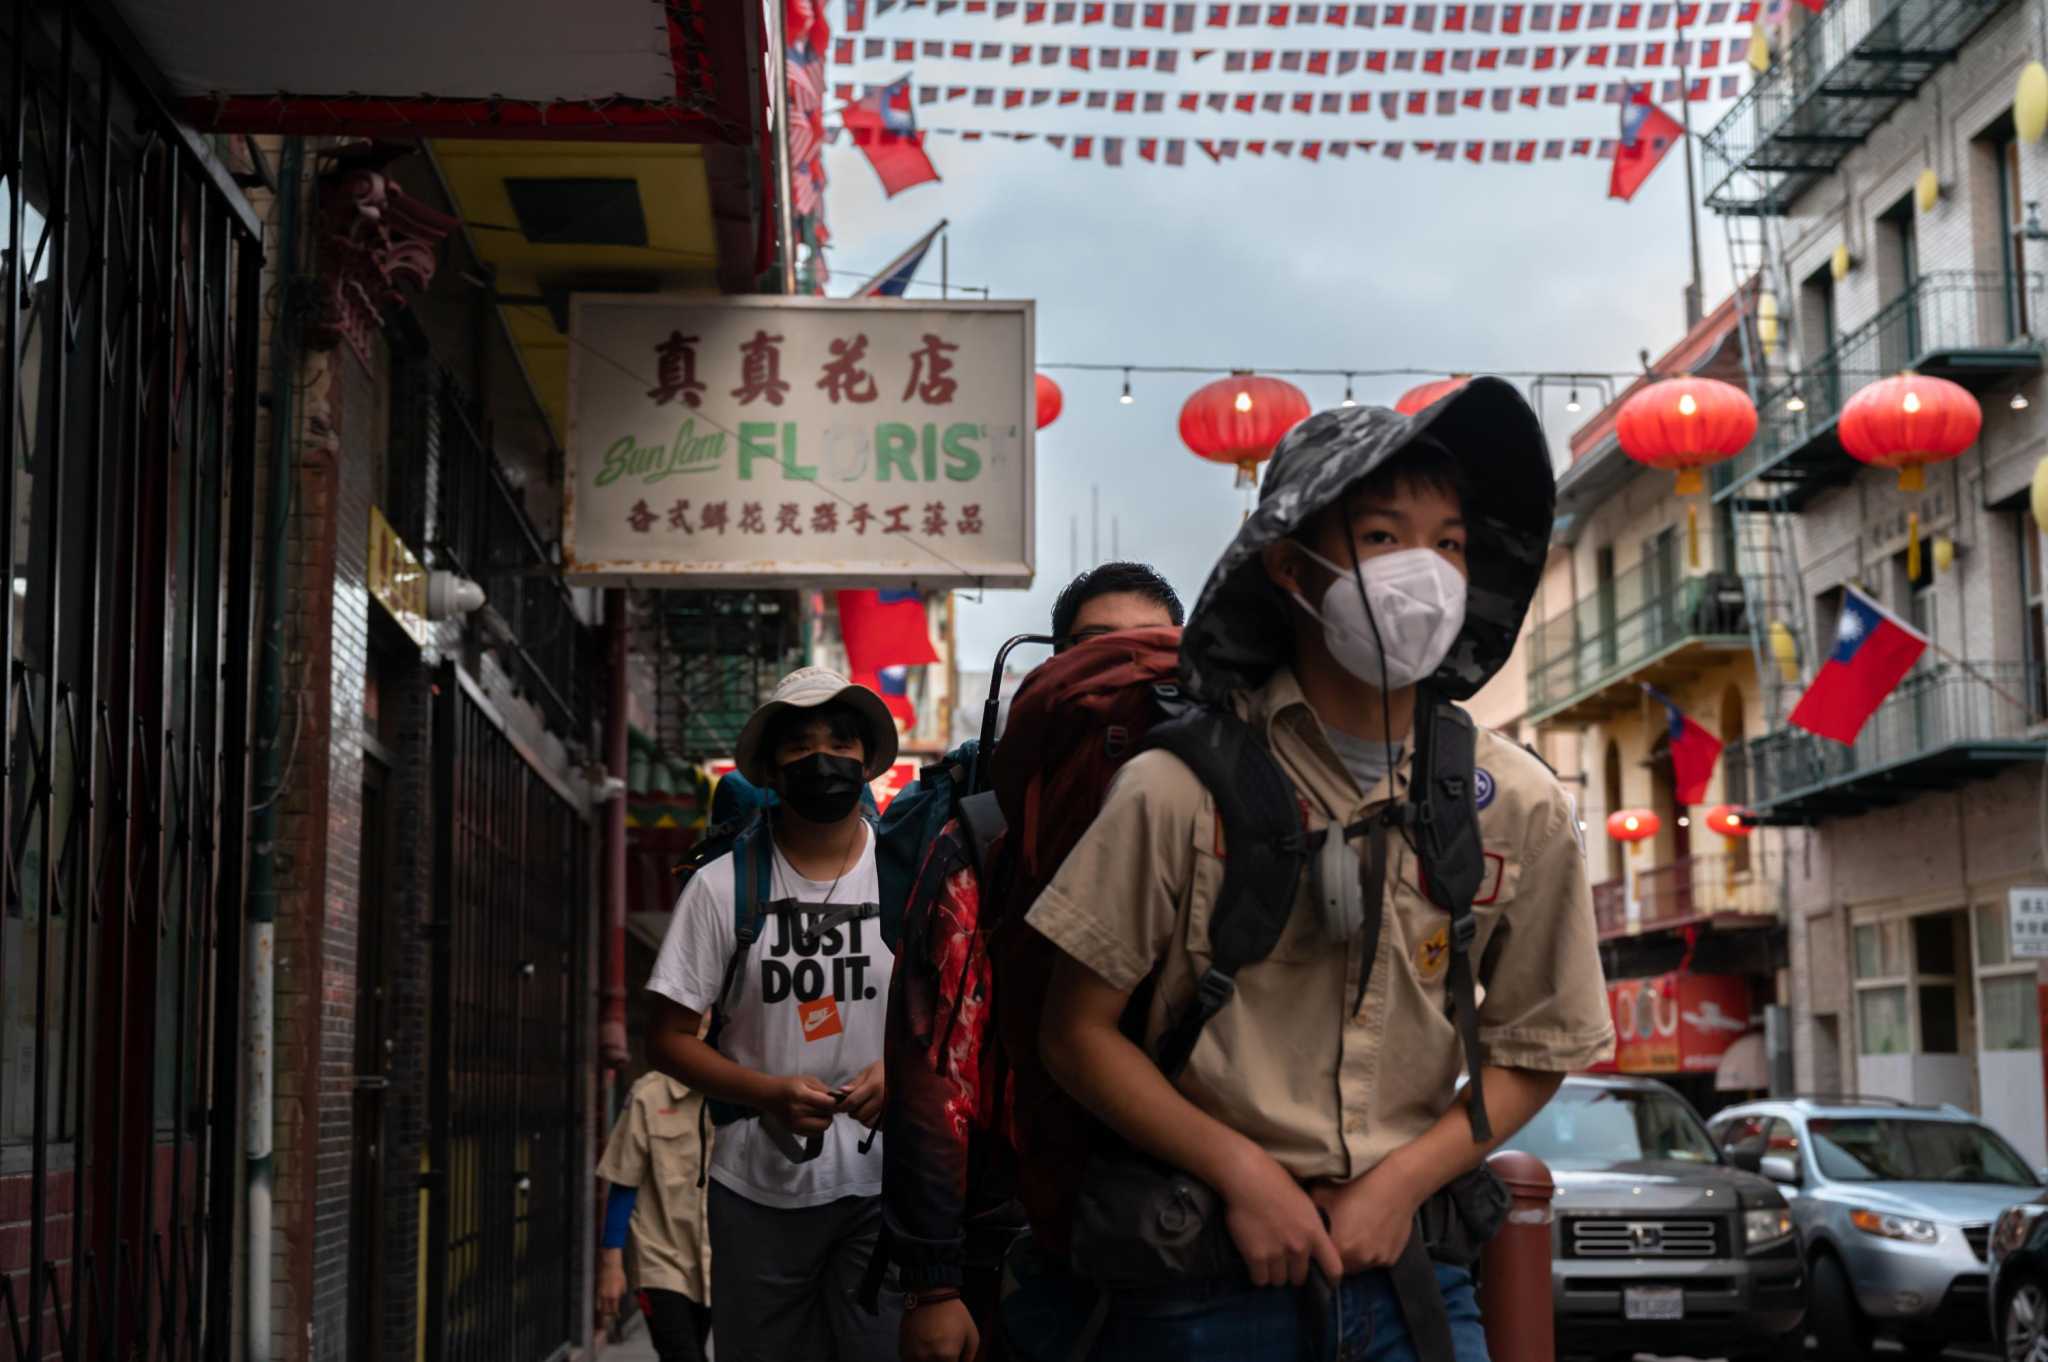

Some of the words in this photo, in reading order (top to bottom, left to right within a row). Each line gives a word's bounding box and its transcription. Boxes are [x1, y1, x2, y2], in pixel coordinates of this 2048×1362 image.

[647, 330, 959, 408] 真真花店
[594, 434, 665, 486] Sun
[738, 422, 1016, 482] FLRIS
[770, 911, 862, 957] JUST
[761, 959, 824, 1004] DO
[833, 956, 877, 1002] IT.
